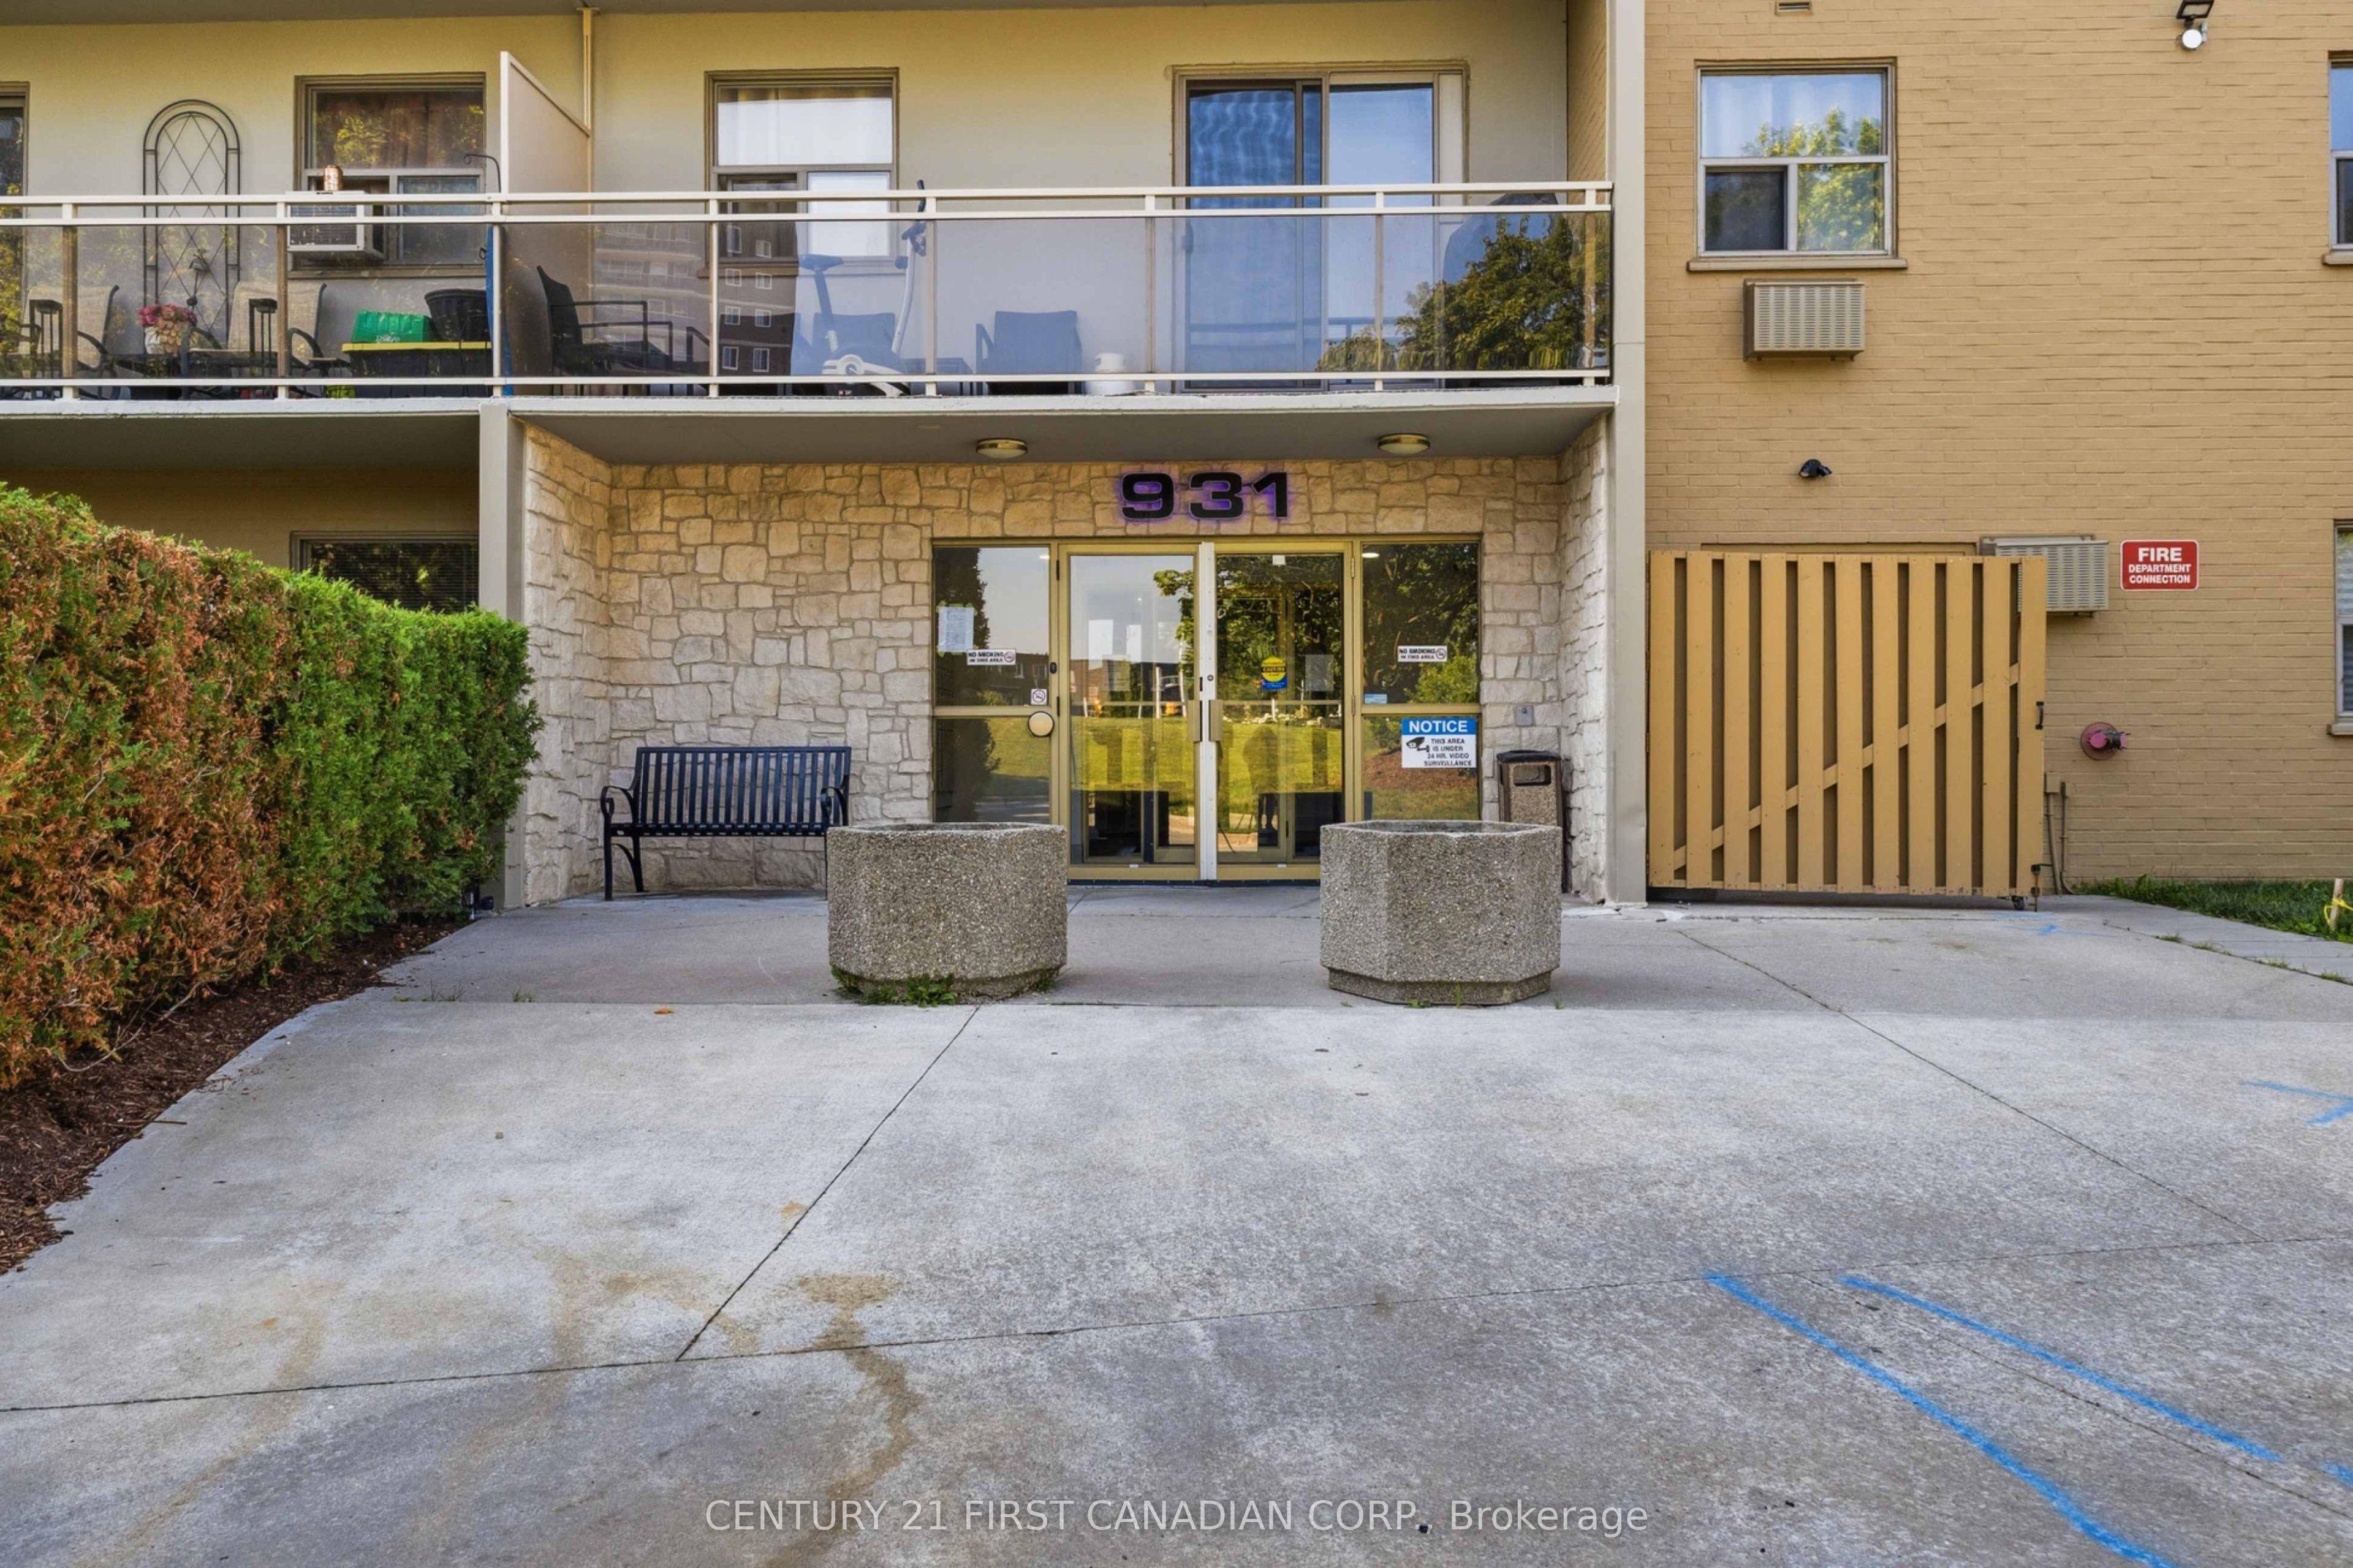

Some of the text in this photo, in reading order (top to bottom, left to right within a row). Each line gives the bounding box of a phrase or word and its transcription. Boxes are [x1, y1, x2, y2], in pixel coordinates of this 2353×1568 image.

[1121, 471, 1288, 520] 931
[2138, 547, 2183, 562] FIRE
[2128, 564, 2191, 573] DEPARTMENT
[2129, 575, 2191, 584] CONNECTION
[1409, 720, 1468, 733] NOTICE
